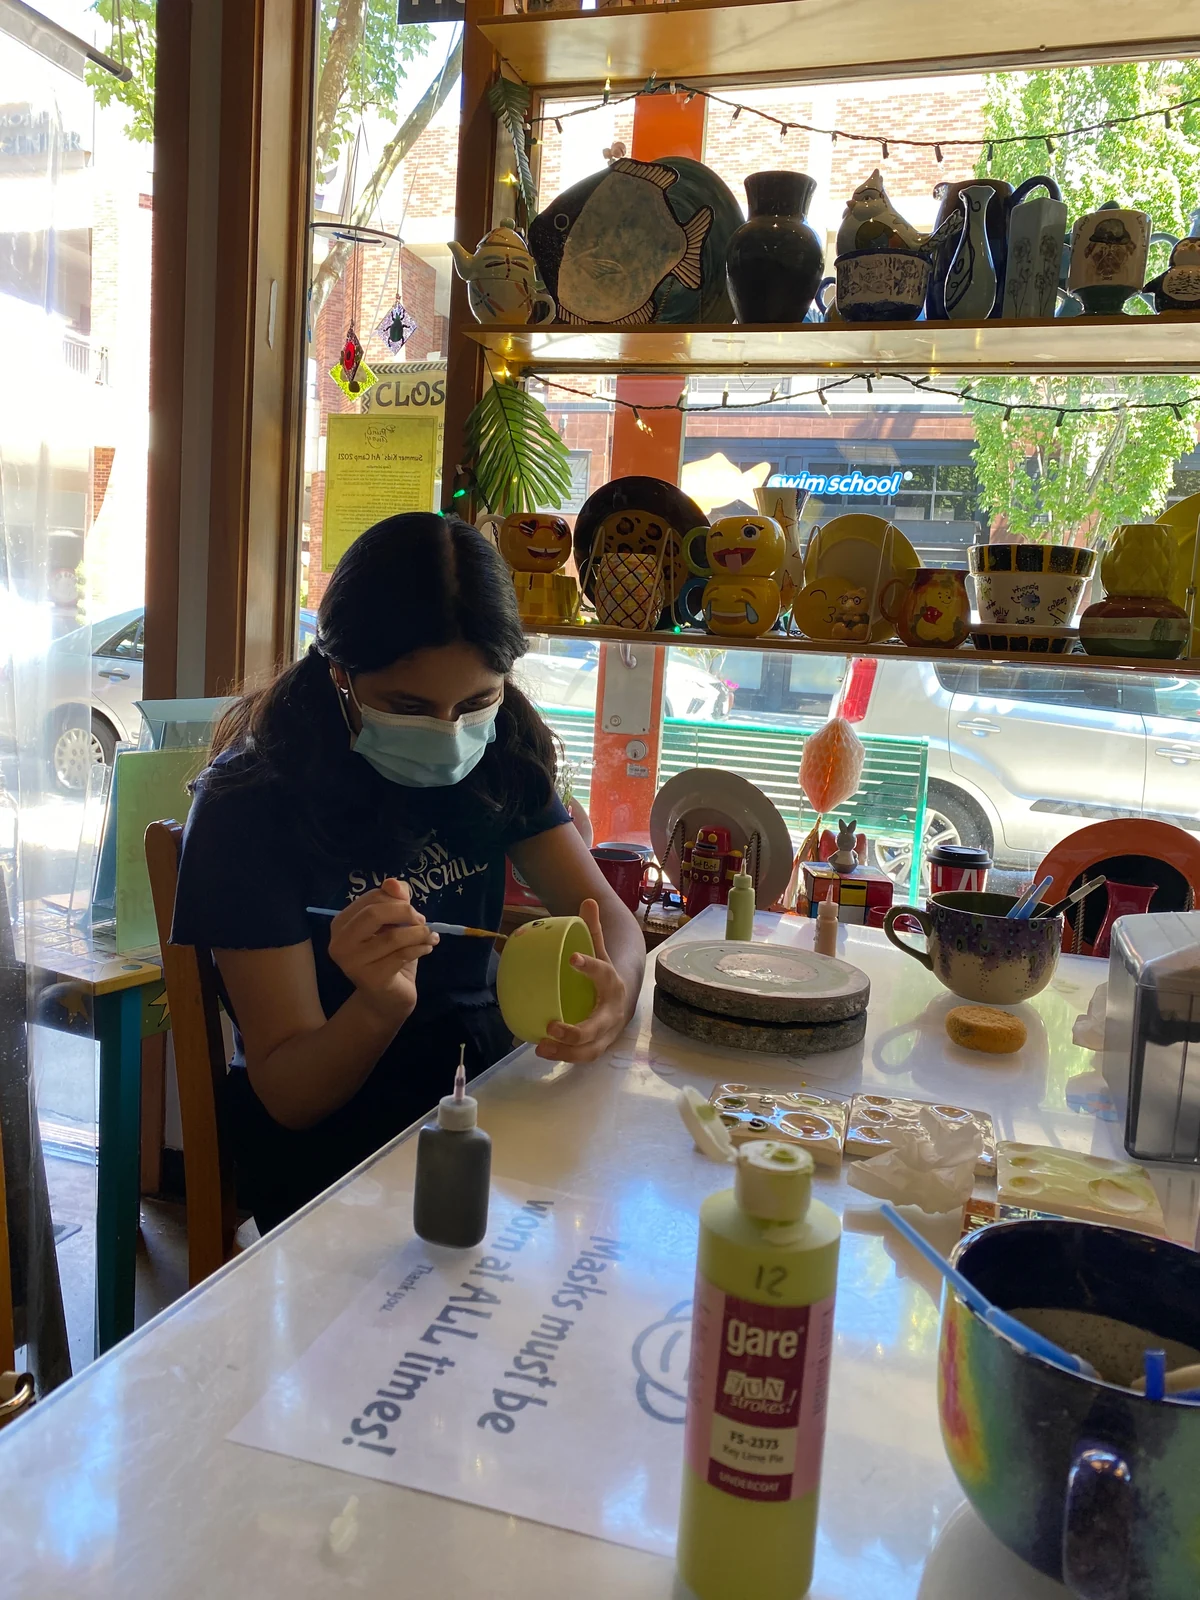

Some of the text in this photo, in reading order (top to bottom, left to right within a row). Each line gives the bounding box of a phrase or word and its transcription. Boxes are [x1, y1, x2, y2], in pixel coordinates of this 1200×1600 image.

[768, 471, 902, 494] swim school
[397, 1263, 434, 1292] Thank
[754, 1264, 788, 1299] 12
[341, 1200, 554, 1457] worn at ALL times!
[477, 1236, 629, 1434] Masks must be
[726, 1318, 798, 1360] gare
[724, 1371, 785, 1401] FUN
[731, 1389, 798, 1415] strokes!
